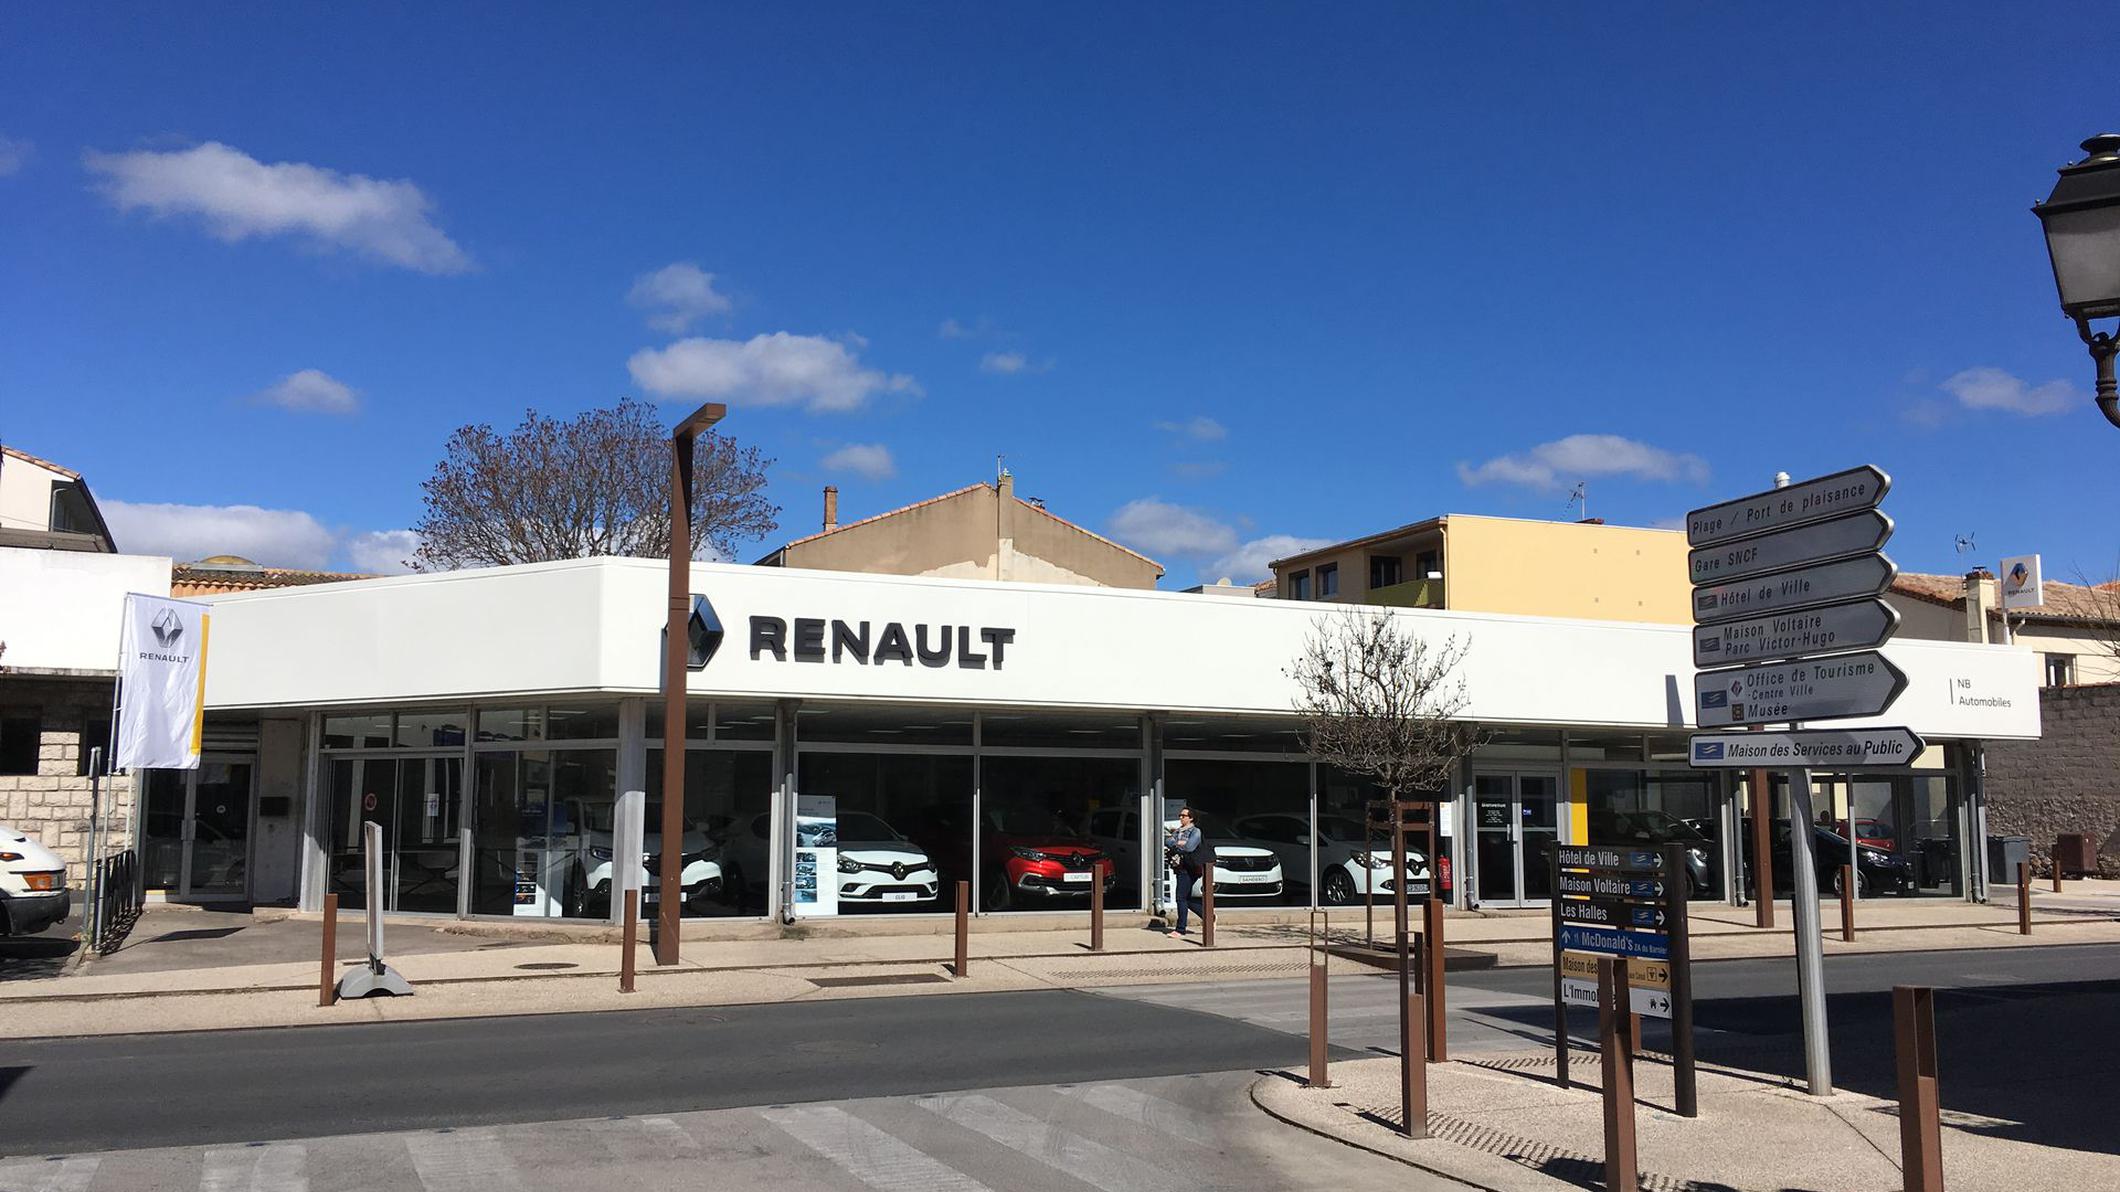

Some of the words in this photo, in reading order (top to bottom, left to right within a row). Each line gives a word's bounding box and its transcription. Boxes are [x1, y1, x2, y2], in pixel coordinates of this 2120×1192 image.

[1692, 518, 1722, 535] Plage
[1747, 506, 1771, 522] Port
[1780, 500, 1794, 514] de
[1802, 484, 1866, 509] plaisance
[1695, 559, 1720, 573] Gare
[1728, 548, 1758, 566] SNCF
[1720, 591, 1751, 605] Hôtel
[1759, 585, 1772, 599] de
[1781, 578, 1811, 596] Ville
[1723, 623, 1764, 641] Maison
[1772, 615, 1822, 632] Voltaire
[749, 615, 1016, 671] RENAULT
[1725, 641, 1750, 655] Parc
[1760, 631, 1835, 650] Victor-Hugo
[140, 652, 189, 664] RENAULT
[1747, 672, 1784, 687] Office
[1791, 669, 1806, 682] de
[1814, 662, 1875, 680] Tourisme
[1957, 678, 1971, 689] NB
[1790, 685, 1814, 697] Ville
[1748, 702, 1789, 718] Musée
[1959, 696, 2012, 708] Automobiles
[1728, 743, 1767, 758] Maison
[1769, 742, 1790, 757] des
[1793, 741, 1842, 756] Services
[1846, 743, 1861, 755] au
[1863, 740, 1903, 755] Public
[1559, 850, 1582, 865] Hôtel
[1584, 852, 1596, 865] de
[1598, 852, 1619, 866] Ville
[1559, 877, 1591, 892] Maison
[1593, 878, 1631, 895] Voltaire
[1560, 903, 1576, 917] Les
[1578, 904, 1608, 921] Halles
[1582, 932, 1633, 951] McDonald's
[1563, 956, 1586, 972] Maison
